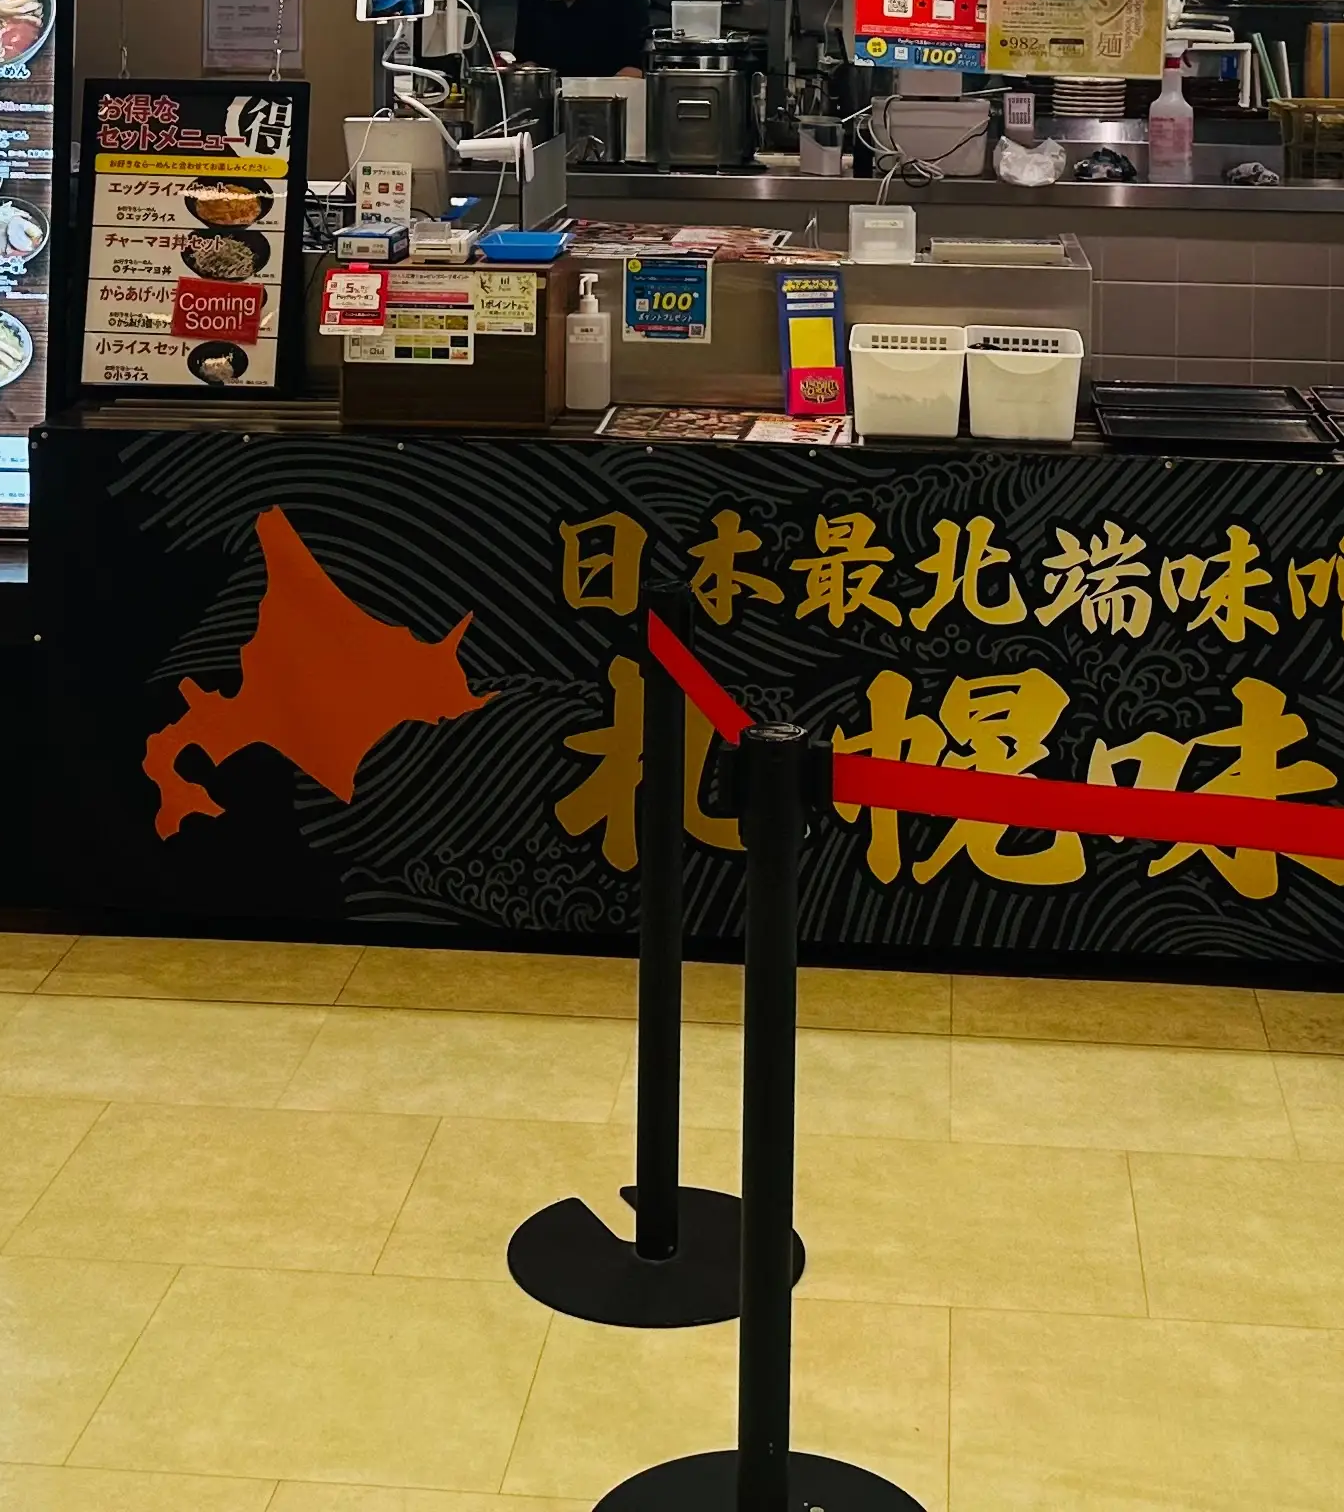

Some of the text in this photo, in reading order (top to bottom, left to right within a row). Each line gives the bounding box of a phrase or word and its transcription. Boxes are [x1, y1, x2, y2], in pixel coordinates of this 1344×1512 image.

[97, 94, 180, 123] お得な
[96, 124, 247, 151] セットメニュー
[179, 292, 256, 316] Coming
[185, 311, 244, 330] Soon!
